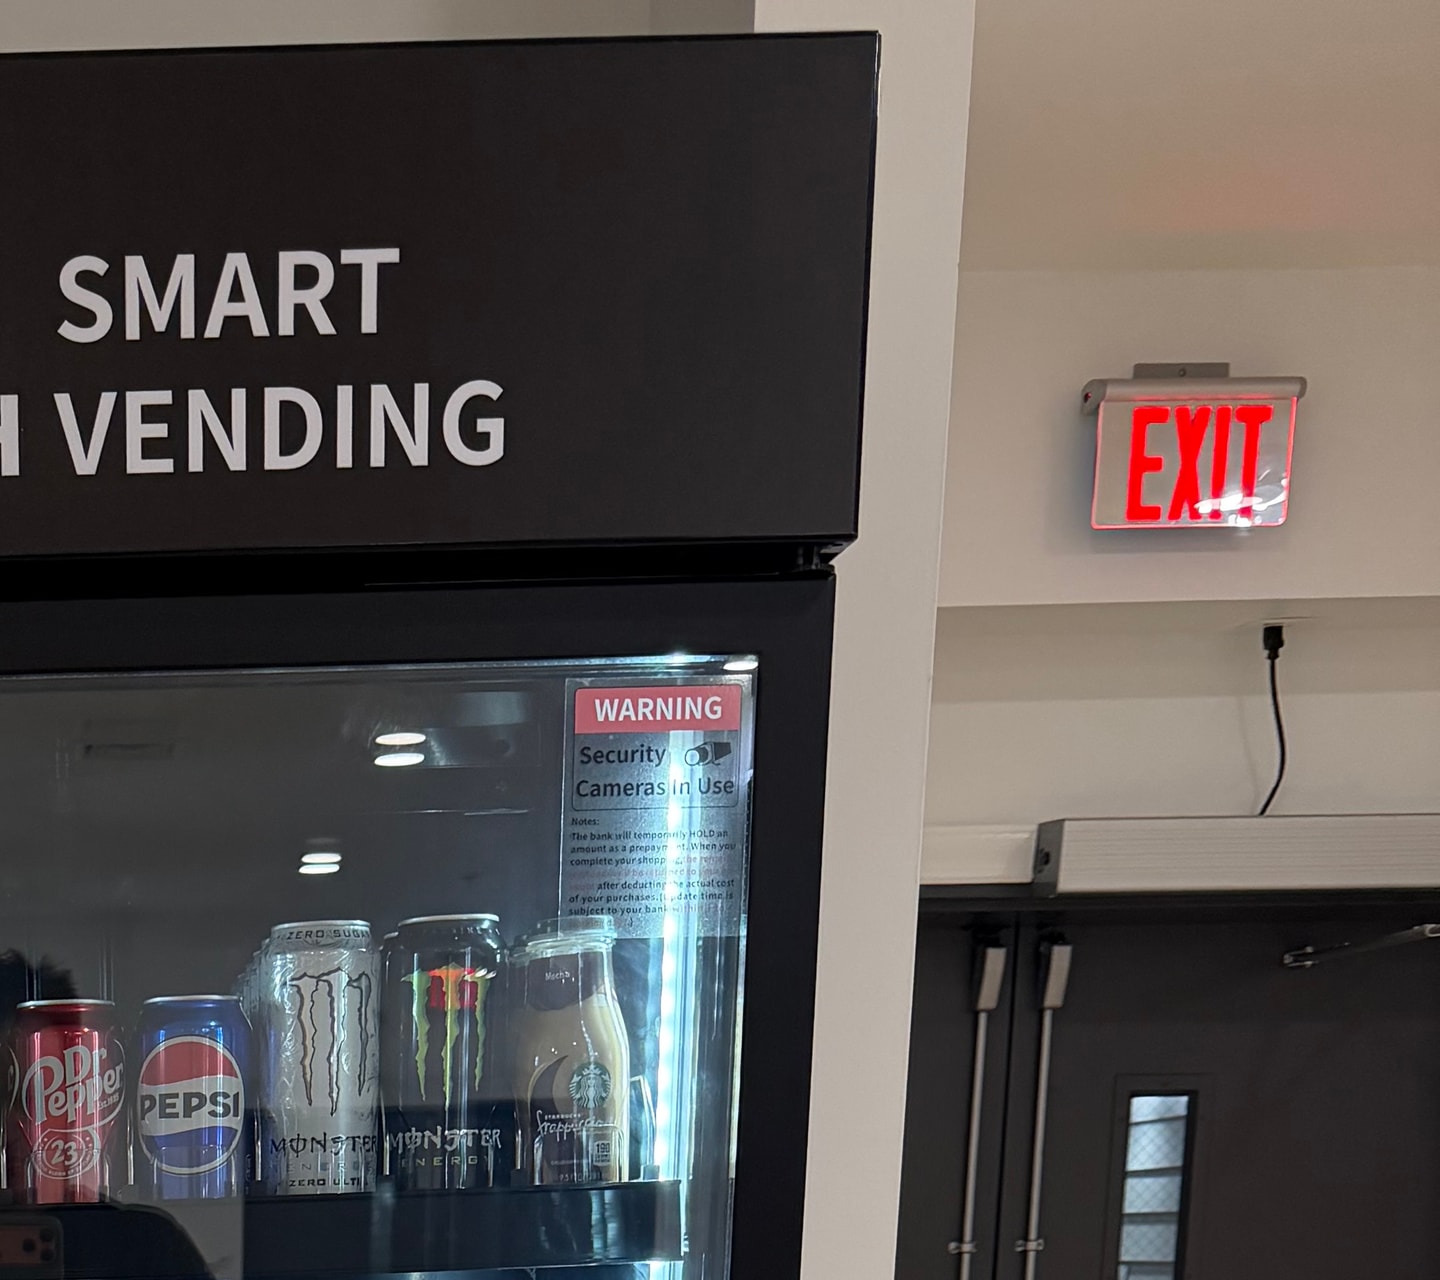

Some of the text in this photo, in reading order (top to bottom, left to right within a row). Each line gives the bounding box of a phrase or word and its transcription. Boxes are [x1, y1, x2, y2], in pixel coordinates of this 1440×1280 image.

[56, 247, 401, 344] SMART
[55, 378, 507, 477] VENDING
[1124, 404, 1275, 523] EXIT
[594, 695, 723, 722] WARNING
[579, 743, 666, 768] Security
[576, 777, 735, 798] Cameras In Use
[571, 817, 600, 827] Notes:
[568, 907, 605, 917] subject
[607, 907, 619, 916] to
[620, 907, 643, 917] your
[63, 1044, 108, 1086] Dr
[21, 1055, 125, 1127] Pepper
[139, 1090, 241, 1121] PEPSI
[269, 1131, 378, 1159] MONSTER
[389, 1125, 502, 1152] MONSTER
[49, 1139, 78, 1166] 23
